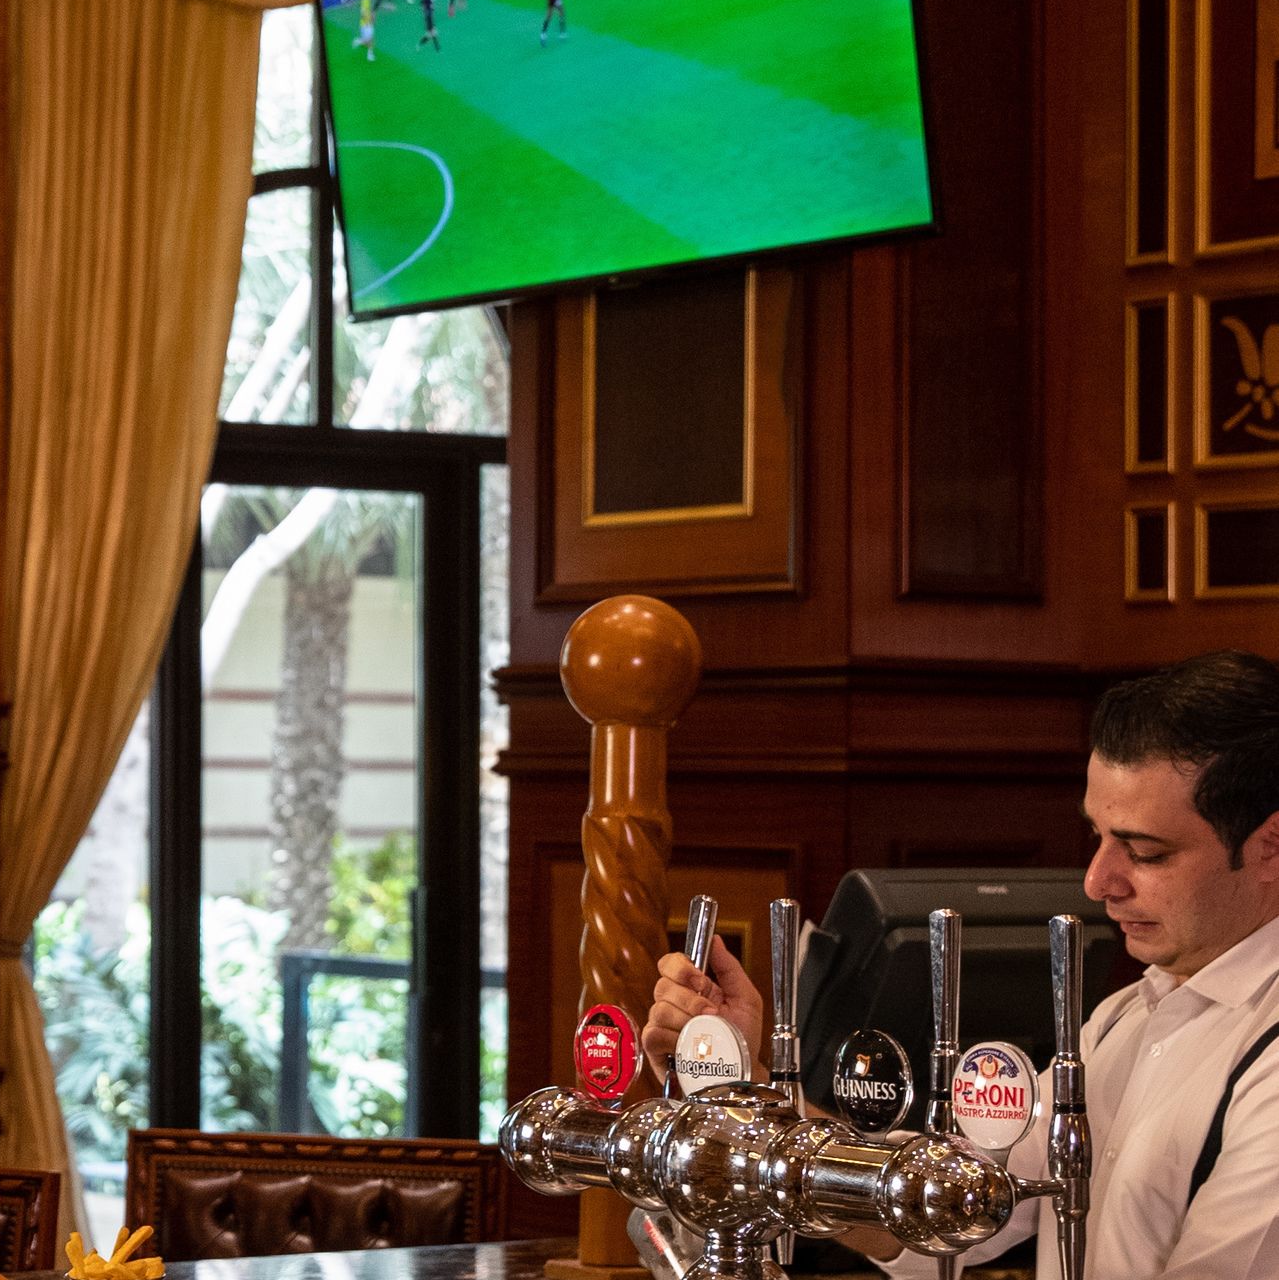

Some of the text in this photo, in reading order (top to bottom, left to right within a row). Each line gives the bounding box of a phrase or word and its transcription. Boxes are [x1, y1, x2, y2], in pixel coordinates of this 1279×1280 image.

[583, 1035, 617, 1050] LONON
[587, 1048, 613, 1058] PRIDE
[833, 1074, 897, 1101] GUINNESS
[954, 1077, 1025, 1108] PERONI
